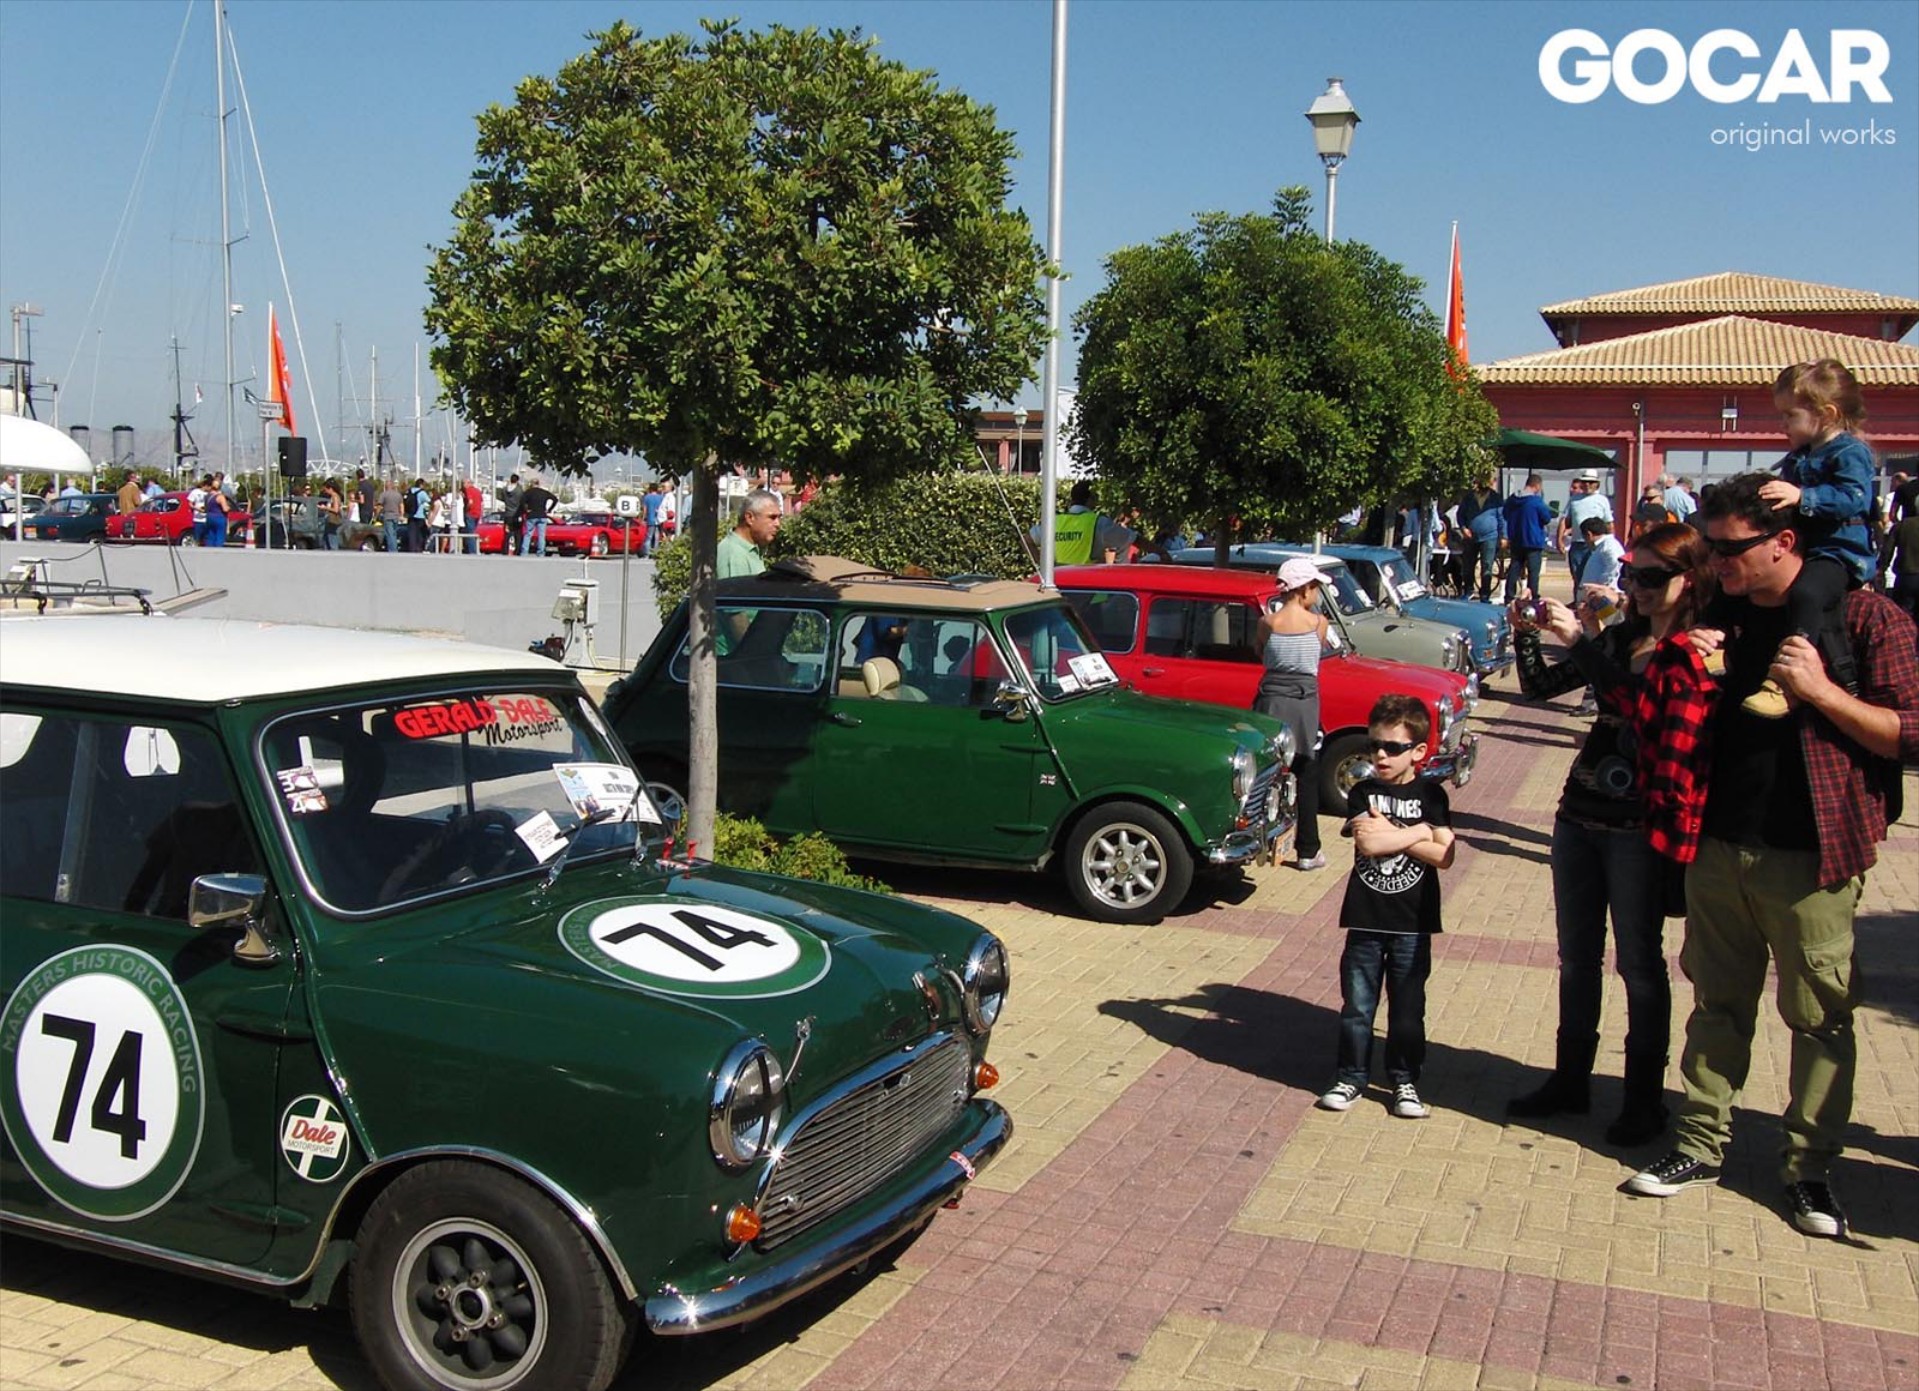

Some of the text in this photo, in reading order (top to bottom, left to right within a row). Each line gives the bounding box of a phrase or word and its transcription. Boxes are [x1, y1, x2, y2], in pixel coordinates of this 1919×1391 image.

[621, 500, 631, 511] B
[1055, 531, 1083, 542] ECURITY
[394, 698, 552, 739] GERALD DALE
[478, 718, 563, 746] Motorsport
[599, 909, 779, 971] 74
[2, 952, 196, 1093] MASTERS HISTORIC RACING
[41, 1012, 147, 1160] 74
[291, 1119, 337, 1145] Dale
[287, 1140, 335, 1155] MOTORSPORT
